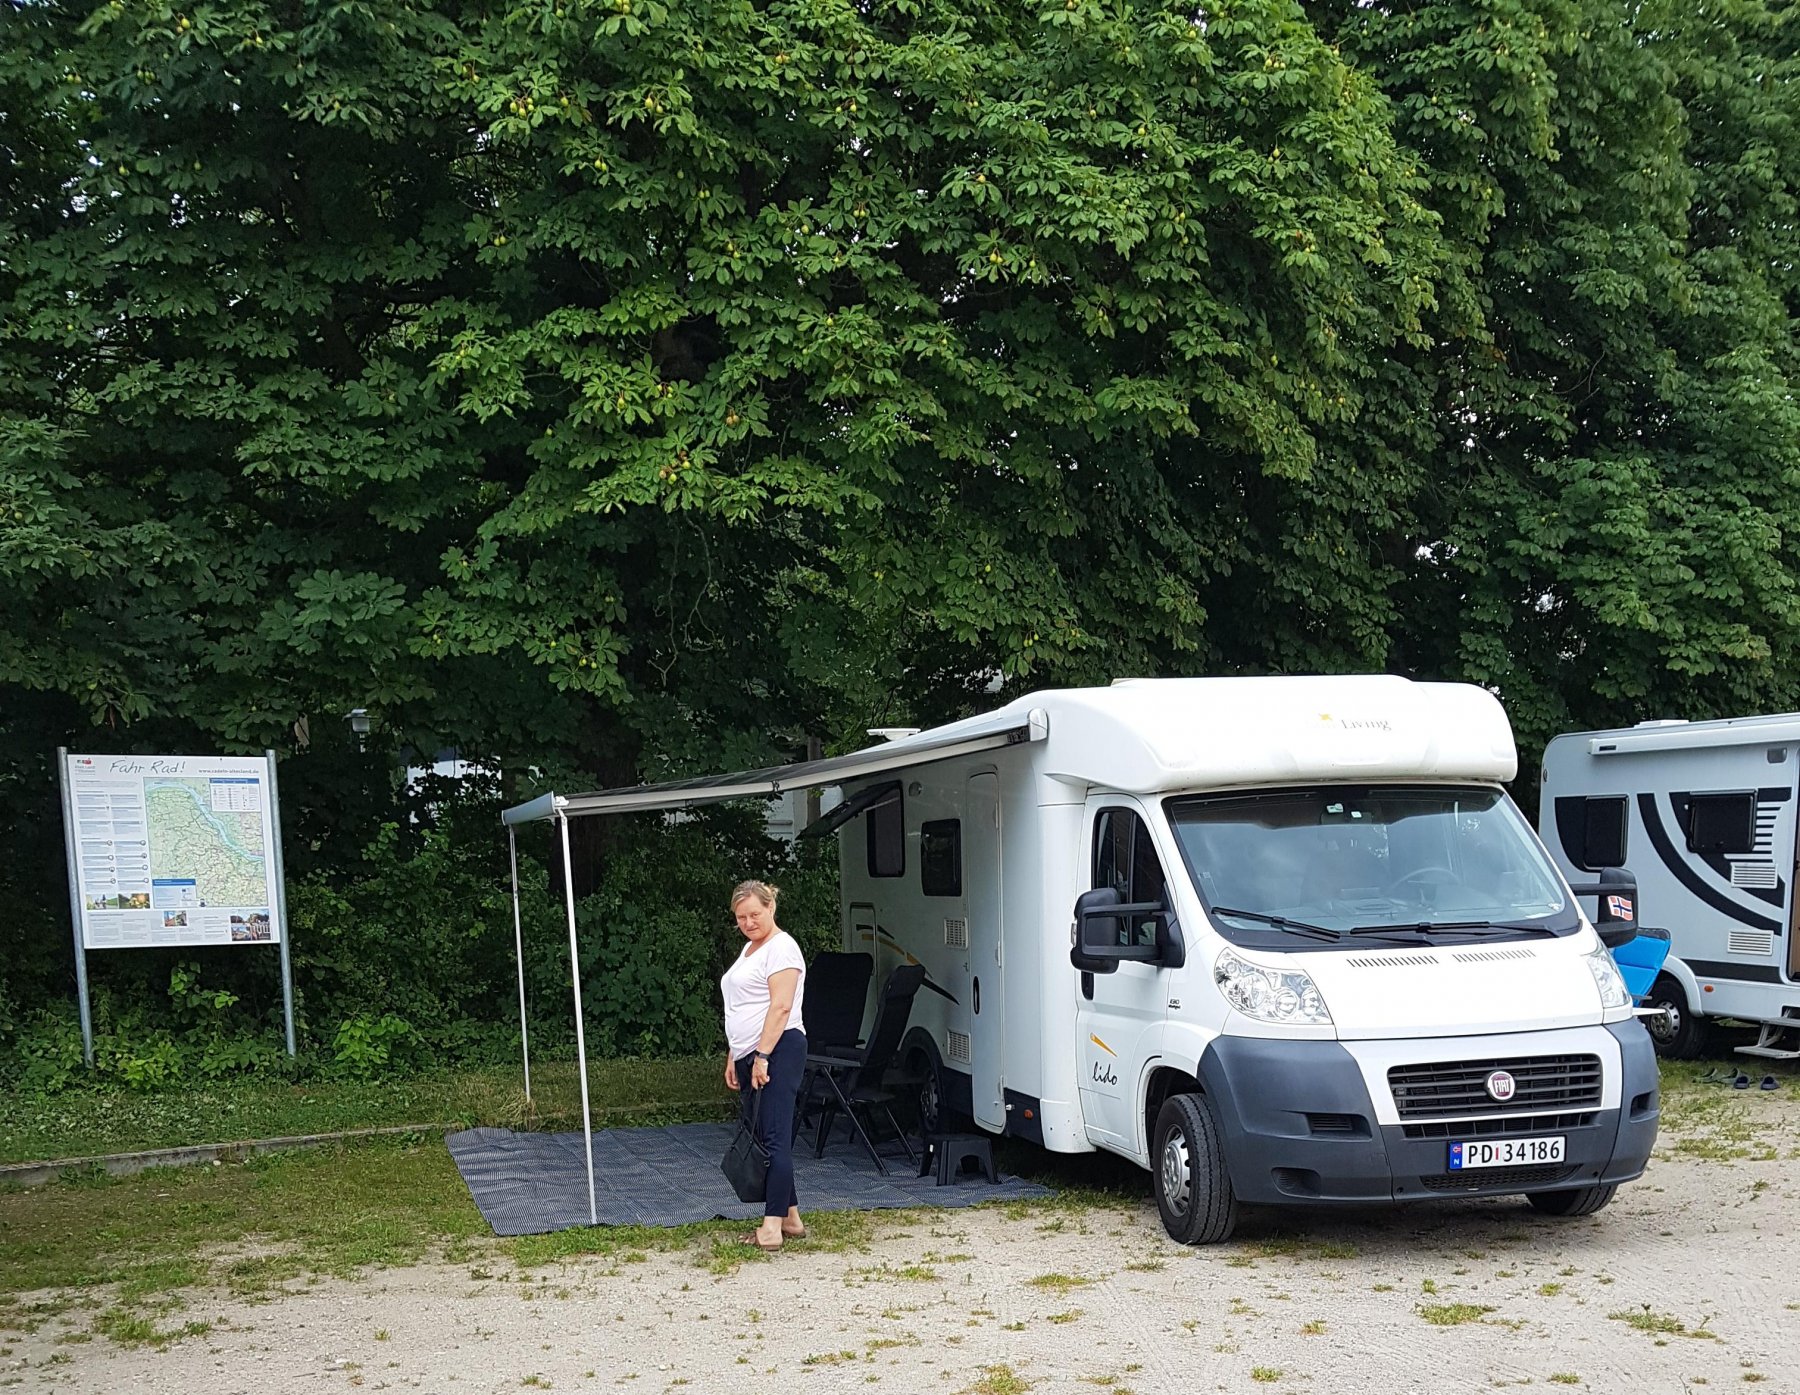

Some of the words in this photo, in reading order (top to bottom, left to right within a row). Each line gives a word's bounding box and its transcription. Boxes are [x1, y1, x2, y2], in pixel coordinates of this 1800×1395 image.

[110, 760, 144, 774] Fahr
[151, 760, 185, 774] Rad!
[1092, 1061, 1118, 1085] lido
[1494, 1079, 1510, 1094] FIAT
